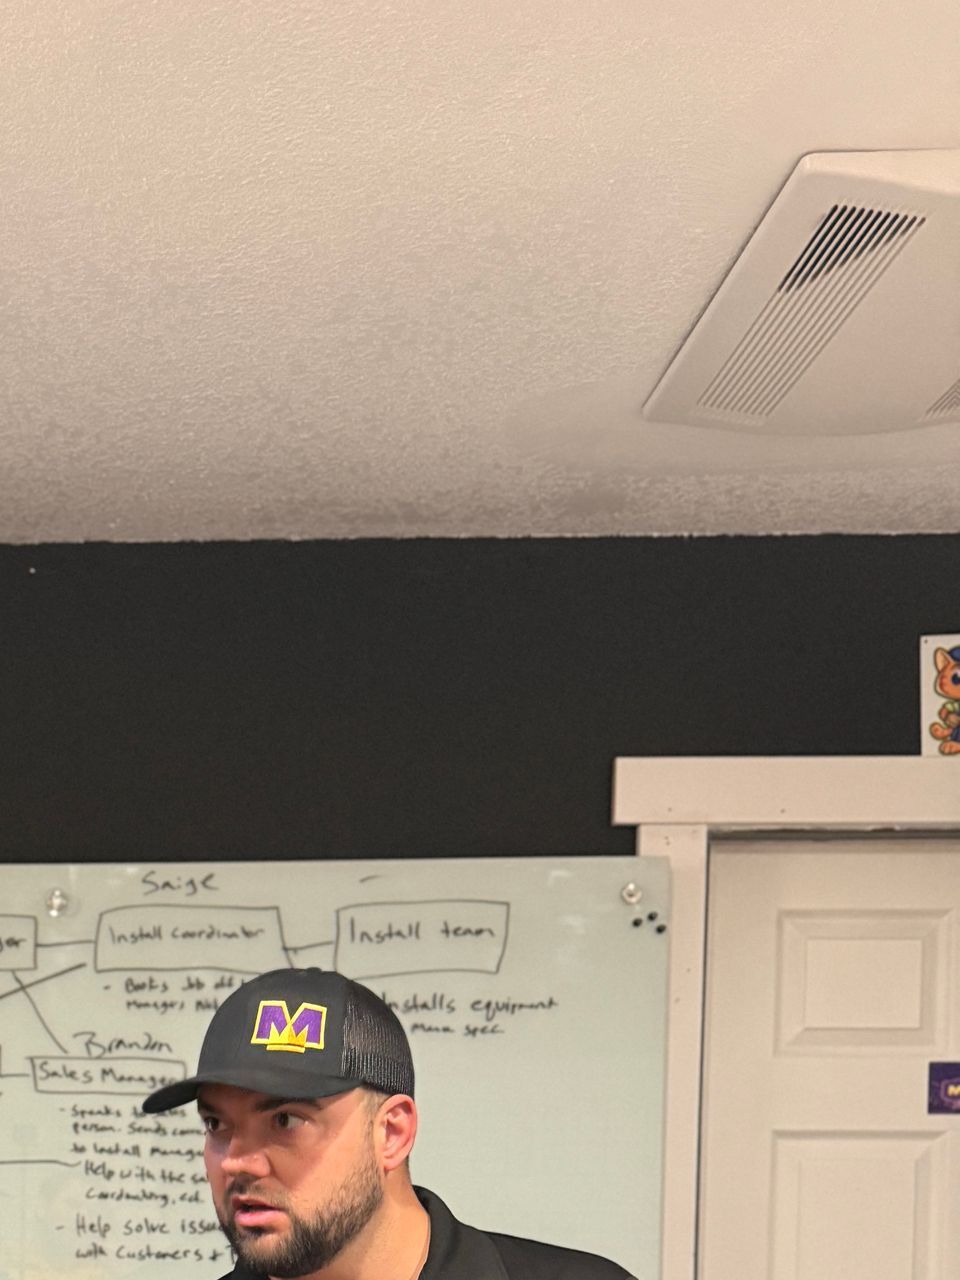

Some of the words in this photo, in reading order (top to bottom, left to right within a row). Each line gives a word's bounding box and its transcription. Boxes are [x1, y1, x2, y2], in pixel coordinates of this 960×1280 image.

[108, 925, 162, 945] Install
[348, 915, 421, 944] Install
[440, 919, 496, 939] team
[72, 1031, 173, 1059] Brandon
[40, 1061, 94, 1084] Sales
[84, 1159, 115, 1182] Help
[161, 1167, 187, 1184] the
[75, 1213, 111, 1238] Help
[123, 1217, 171, 1235] solve
